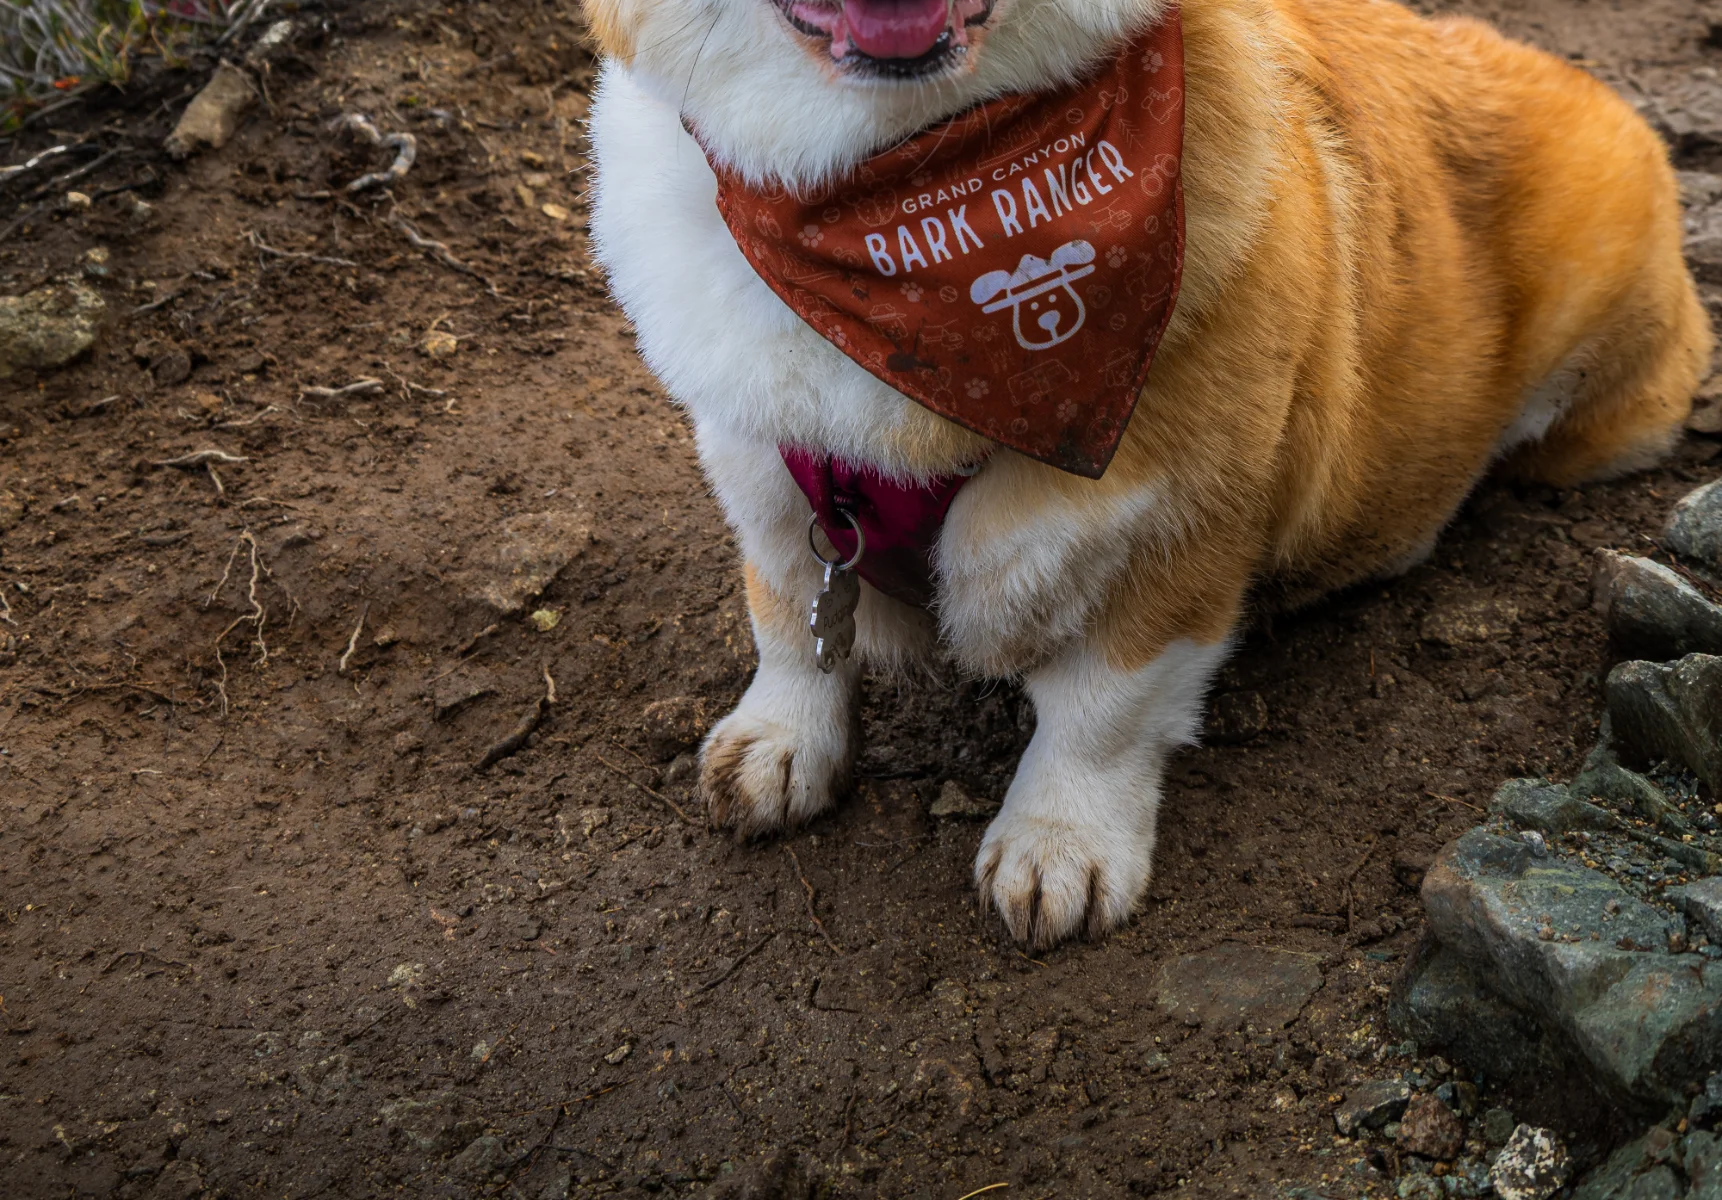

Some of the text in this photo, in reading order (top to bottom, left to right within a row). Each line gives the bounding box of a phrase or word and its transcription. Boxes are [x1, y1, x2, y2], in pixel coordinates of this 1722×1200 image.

[865, 140, 1134, 277] BARK RANGER
[901, 131, 1086, 214] GRAND CANYON
